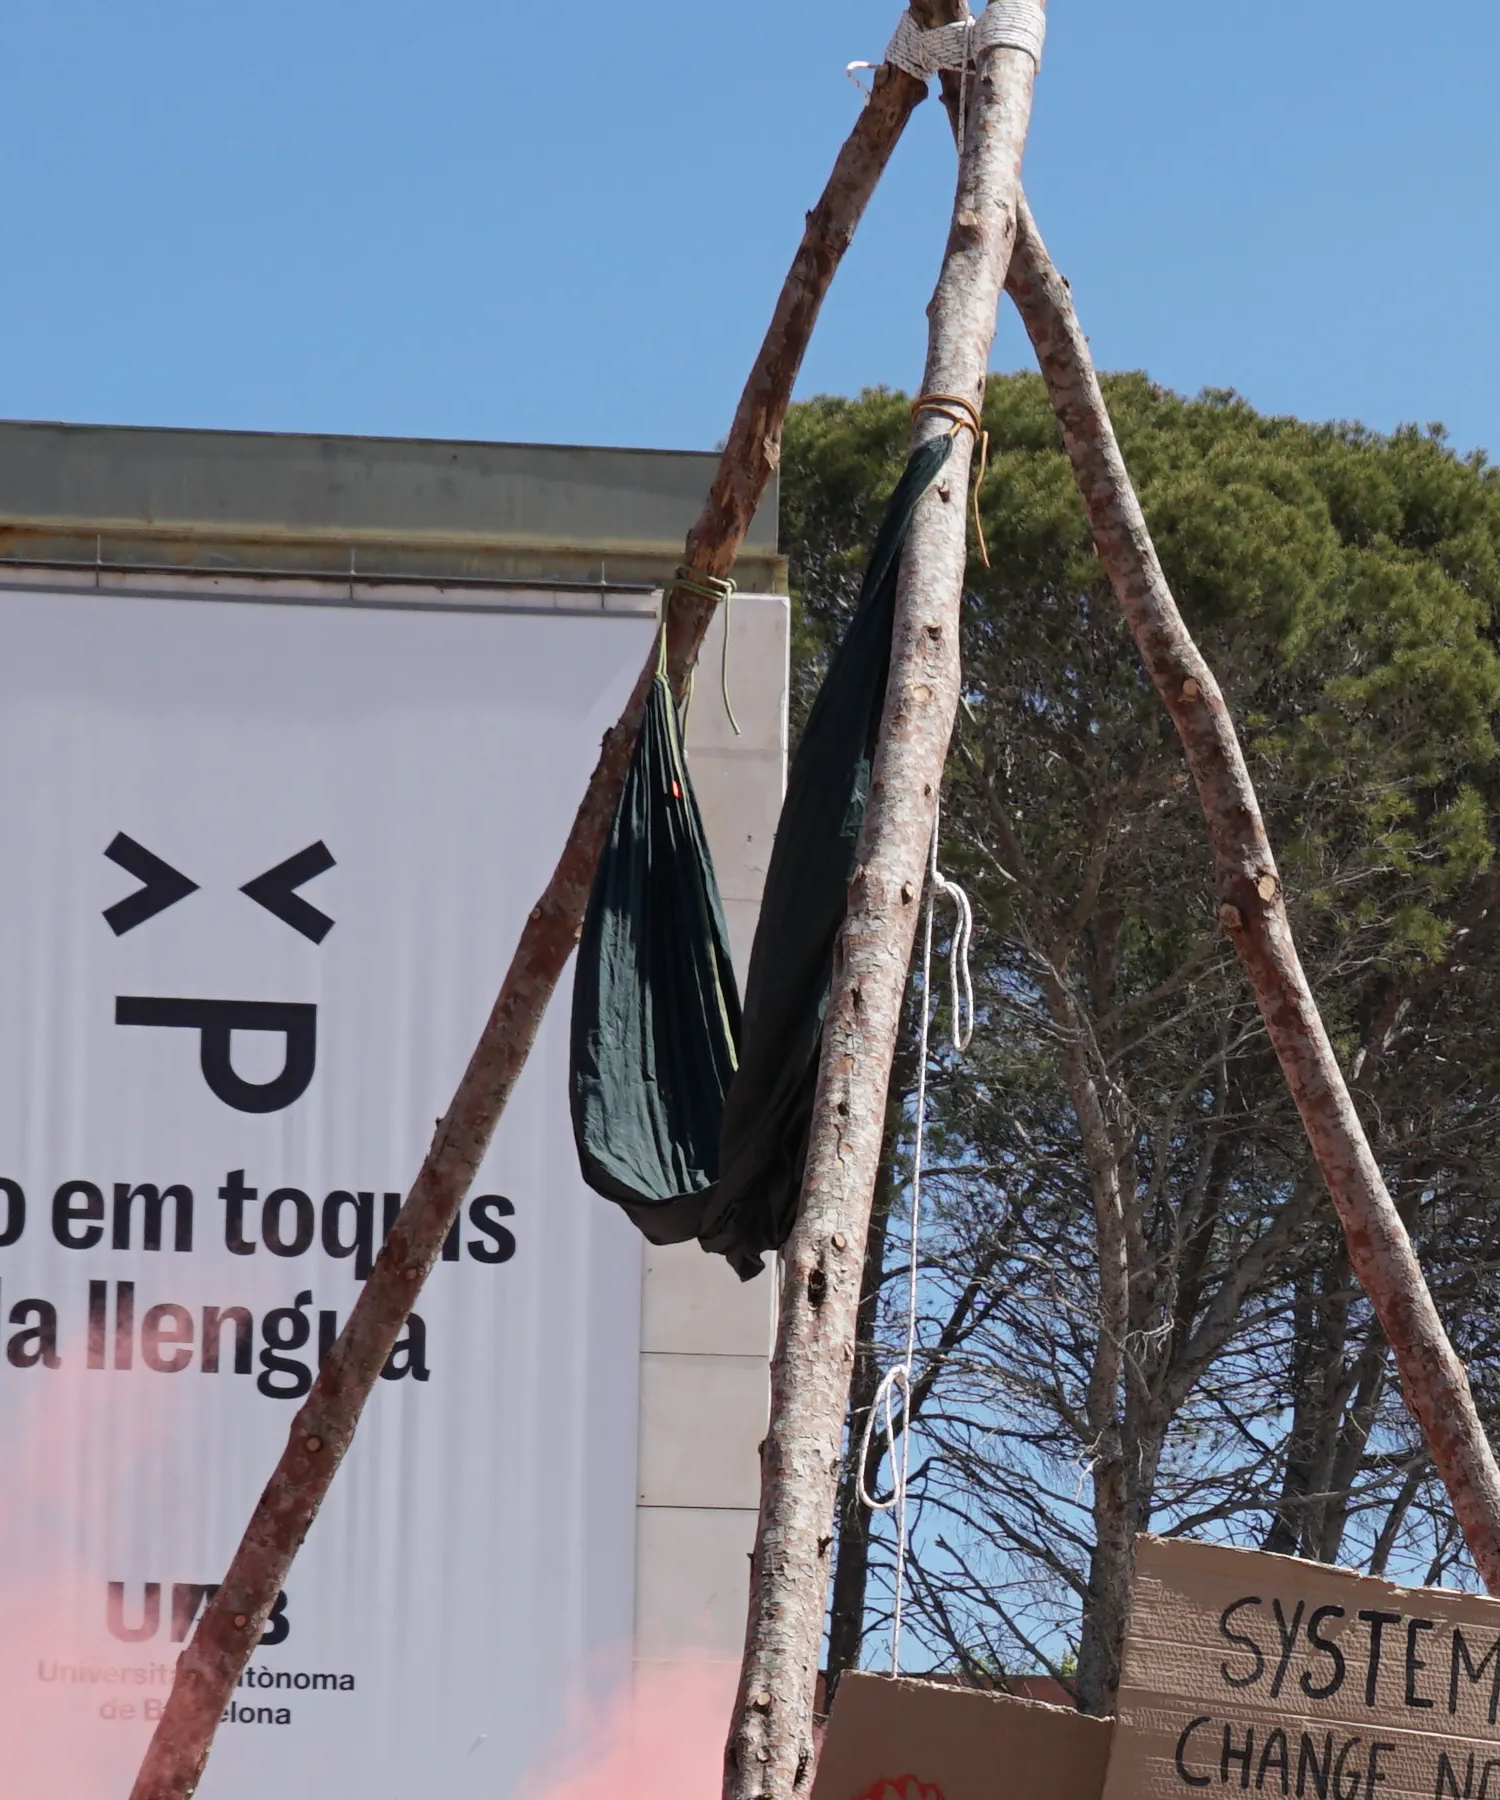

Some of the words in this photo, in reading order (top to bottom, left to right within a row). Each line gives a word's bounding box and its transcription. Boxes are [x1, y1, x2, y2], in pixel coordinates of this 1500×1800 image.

[51, 1179, 194, 1252] em
[218, 1169, 517, 1281] toqs
[37, 1659, 177, 1686] Universit
[235, 1665, 355, 1691] tònoma
